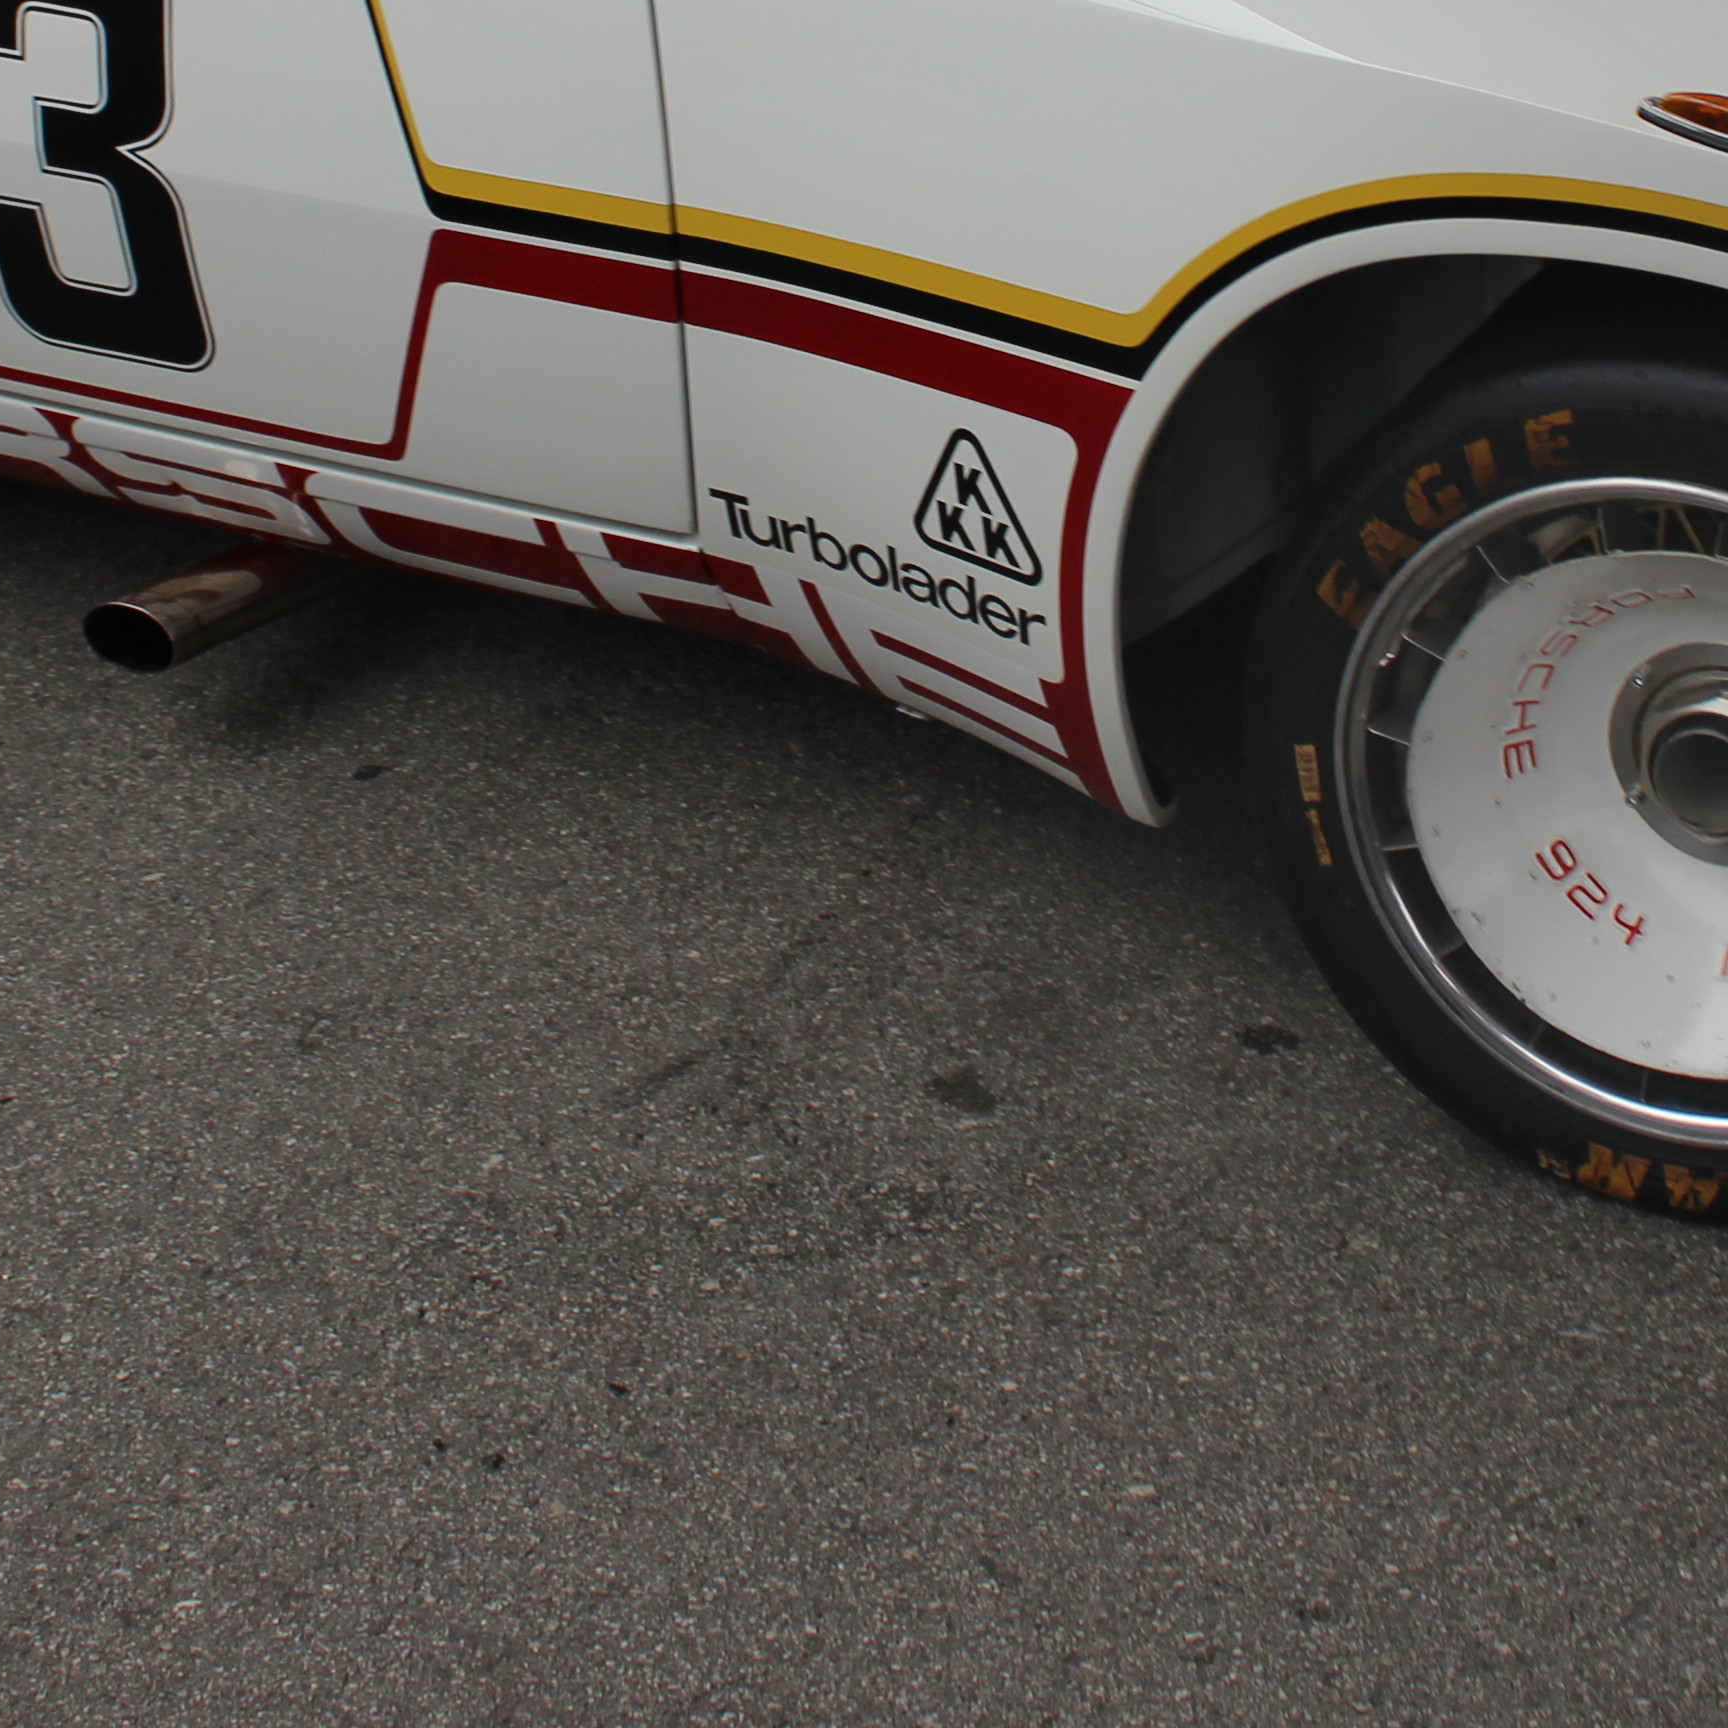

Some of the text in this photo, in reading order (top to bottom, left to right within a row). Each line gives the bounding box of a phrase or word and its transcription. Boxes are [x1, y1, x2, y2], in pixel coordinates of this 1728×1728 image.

[708, 487, 1047, 647] Turbolader
[1502, 584, 1697, 780] PORSCHE
[1535, 838, 1646, 947] 924
